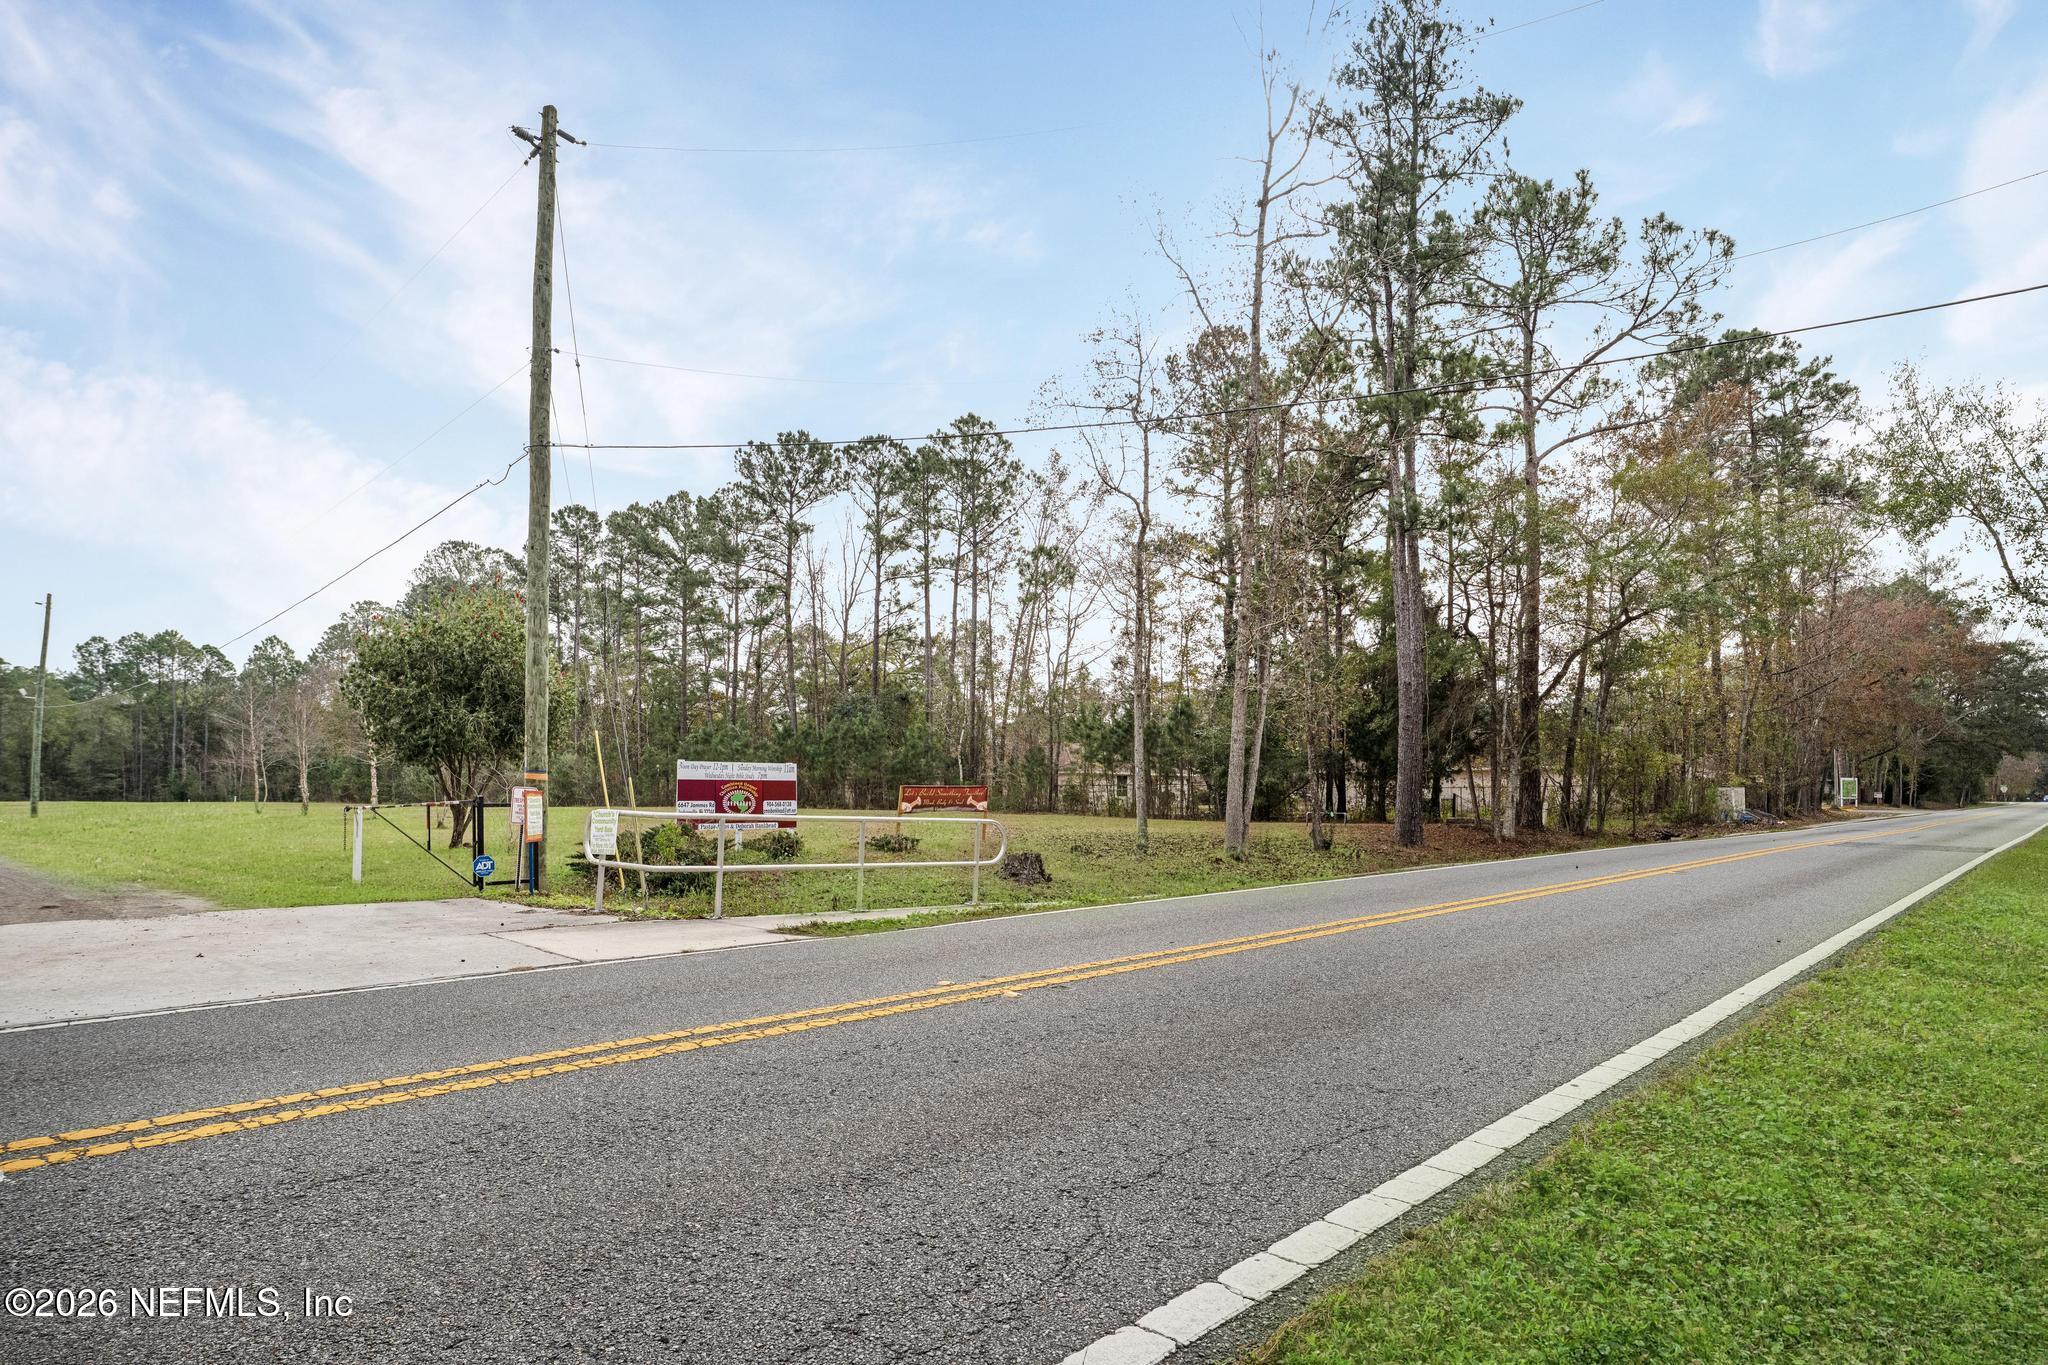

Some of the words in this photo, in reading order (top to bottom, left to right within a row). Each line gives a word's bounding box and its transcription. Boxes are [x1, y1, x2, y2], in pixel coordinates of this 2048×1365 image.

[737, 764, 752, 772] Sunday
[919, 788, 936, 796] Build
[935, 788, 961, 797] Something
[476, 861, 493, 870] ADT
